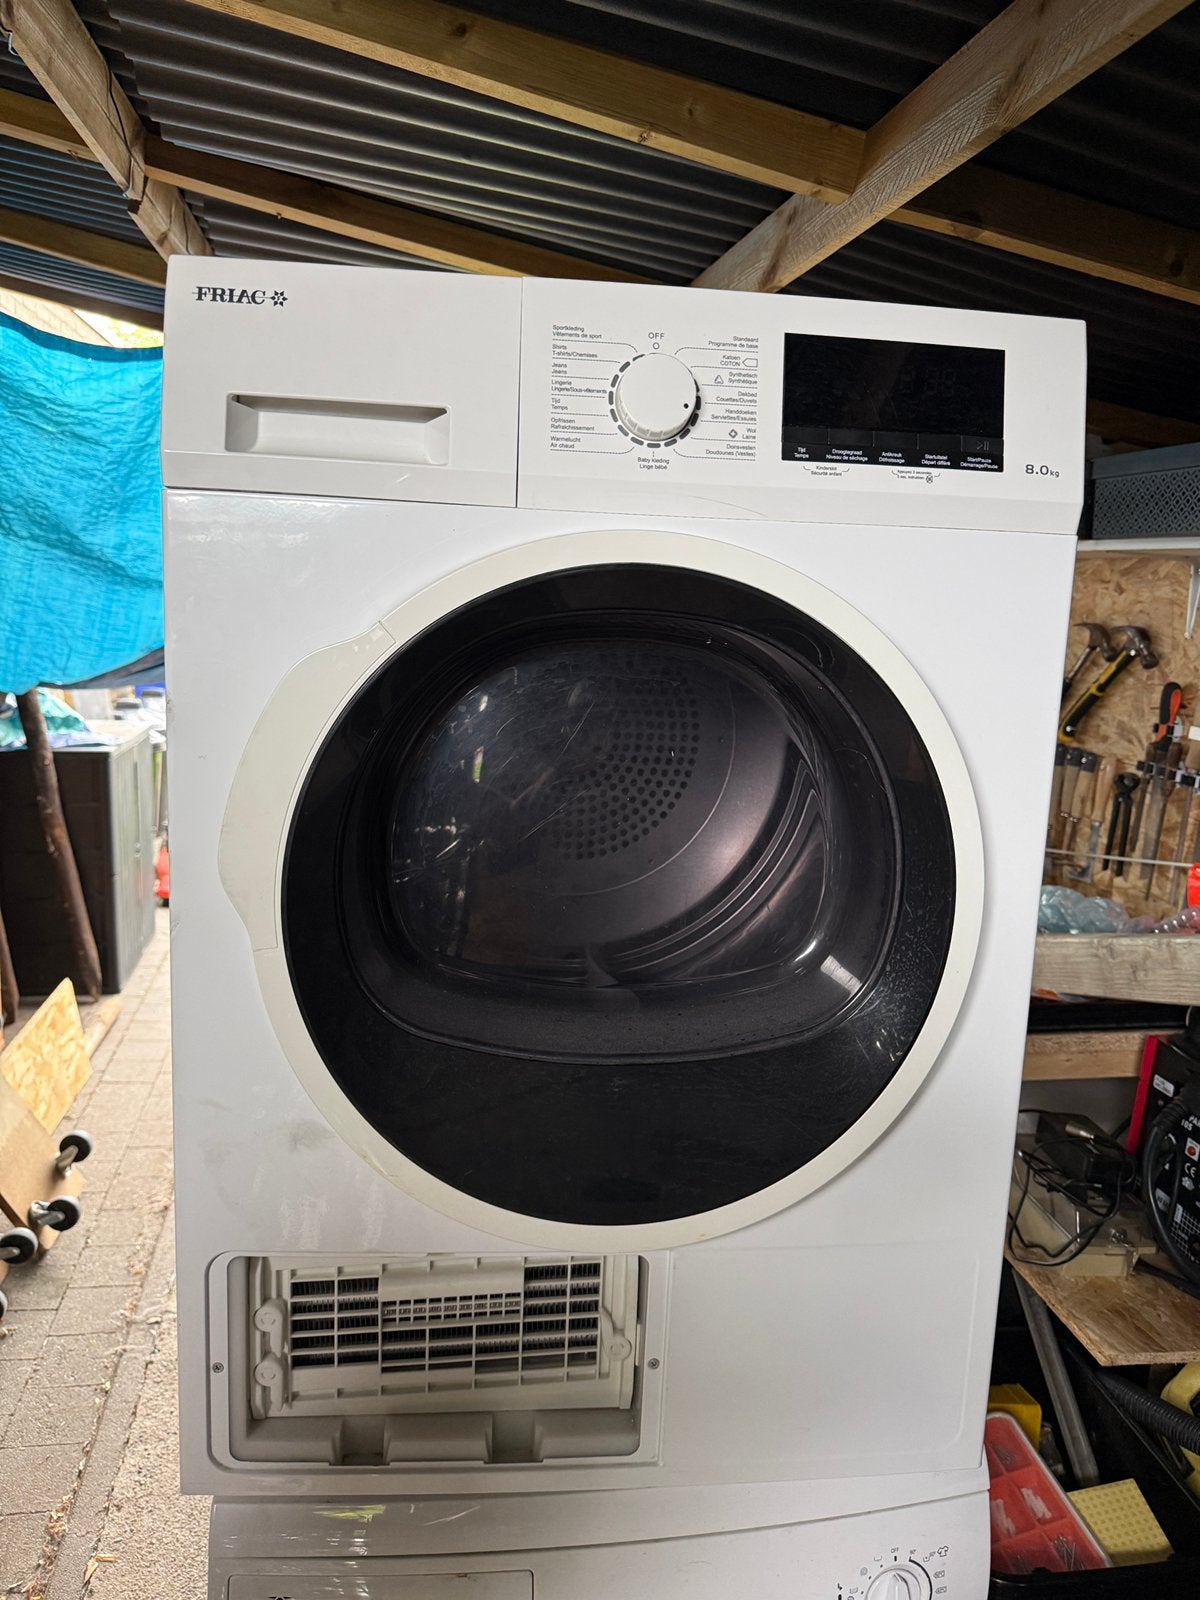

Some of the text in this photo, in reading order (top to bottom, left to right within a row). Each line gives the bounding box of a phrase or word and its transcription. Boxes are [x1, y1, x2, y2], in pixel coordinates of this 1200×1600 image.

[195, 286, 266, 305] FRIAC
[552, 324, 584, 332] Sportkleding
[648, 332, 665, 340] OFF
[552, 350, 598, 358] T-shirts/Chemises
[921, 459, 936, 467] Départ
[960, 461, 998, 470] Démarrage/Pause
